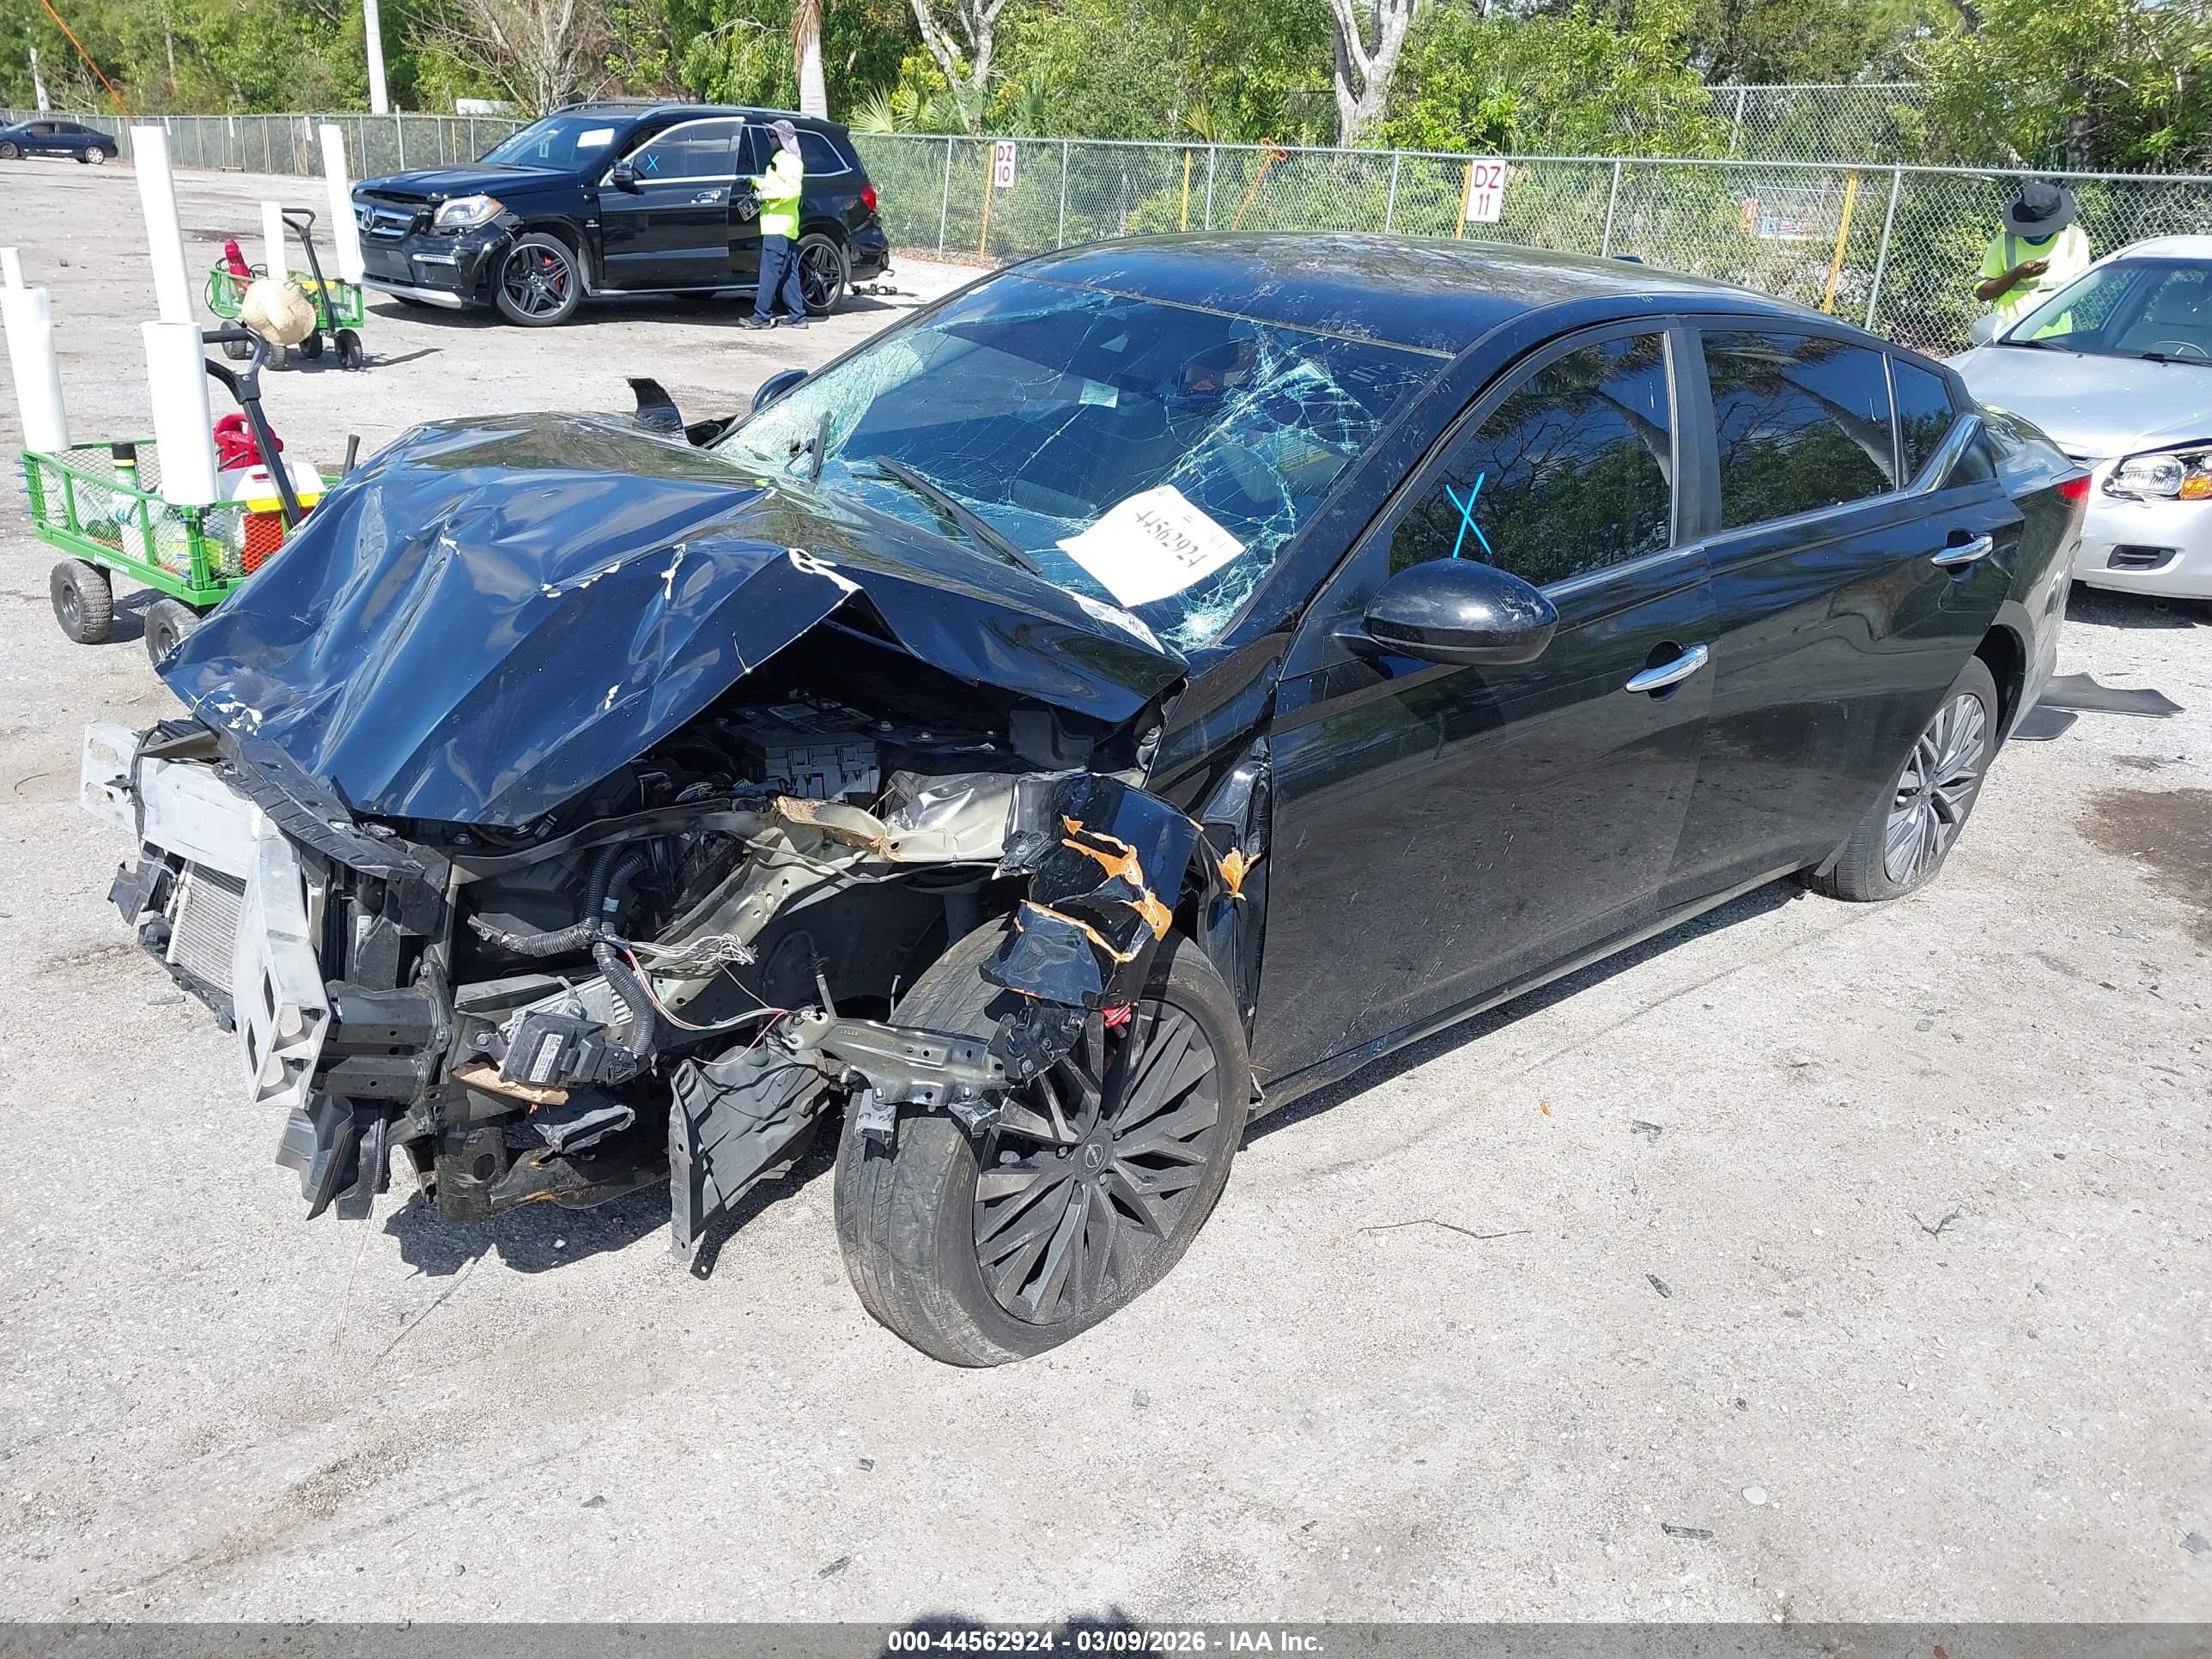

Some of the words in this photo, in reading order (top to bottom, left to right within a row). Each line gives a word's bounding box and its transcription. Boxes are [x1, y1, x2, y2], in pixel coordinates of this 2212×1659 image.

[997, 144, 1013, 161] DZ
[998, 165, 1011, 182] 10
[1474, 165, 1501, 189] DZ
[1479, 193, 1491, 216] 11
[1135, 509, 1208, 568] 44562924
